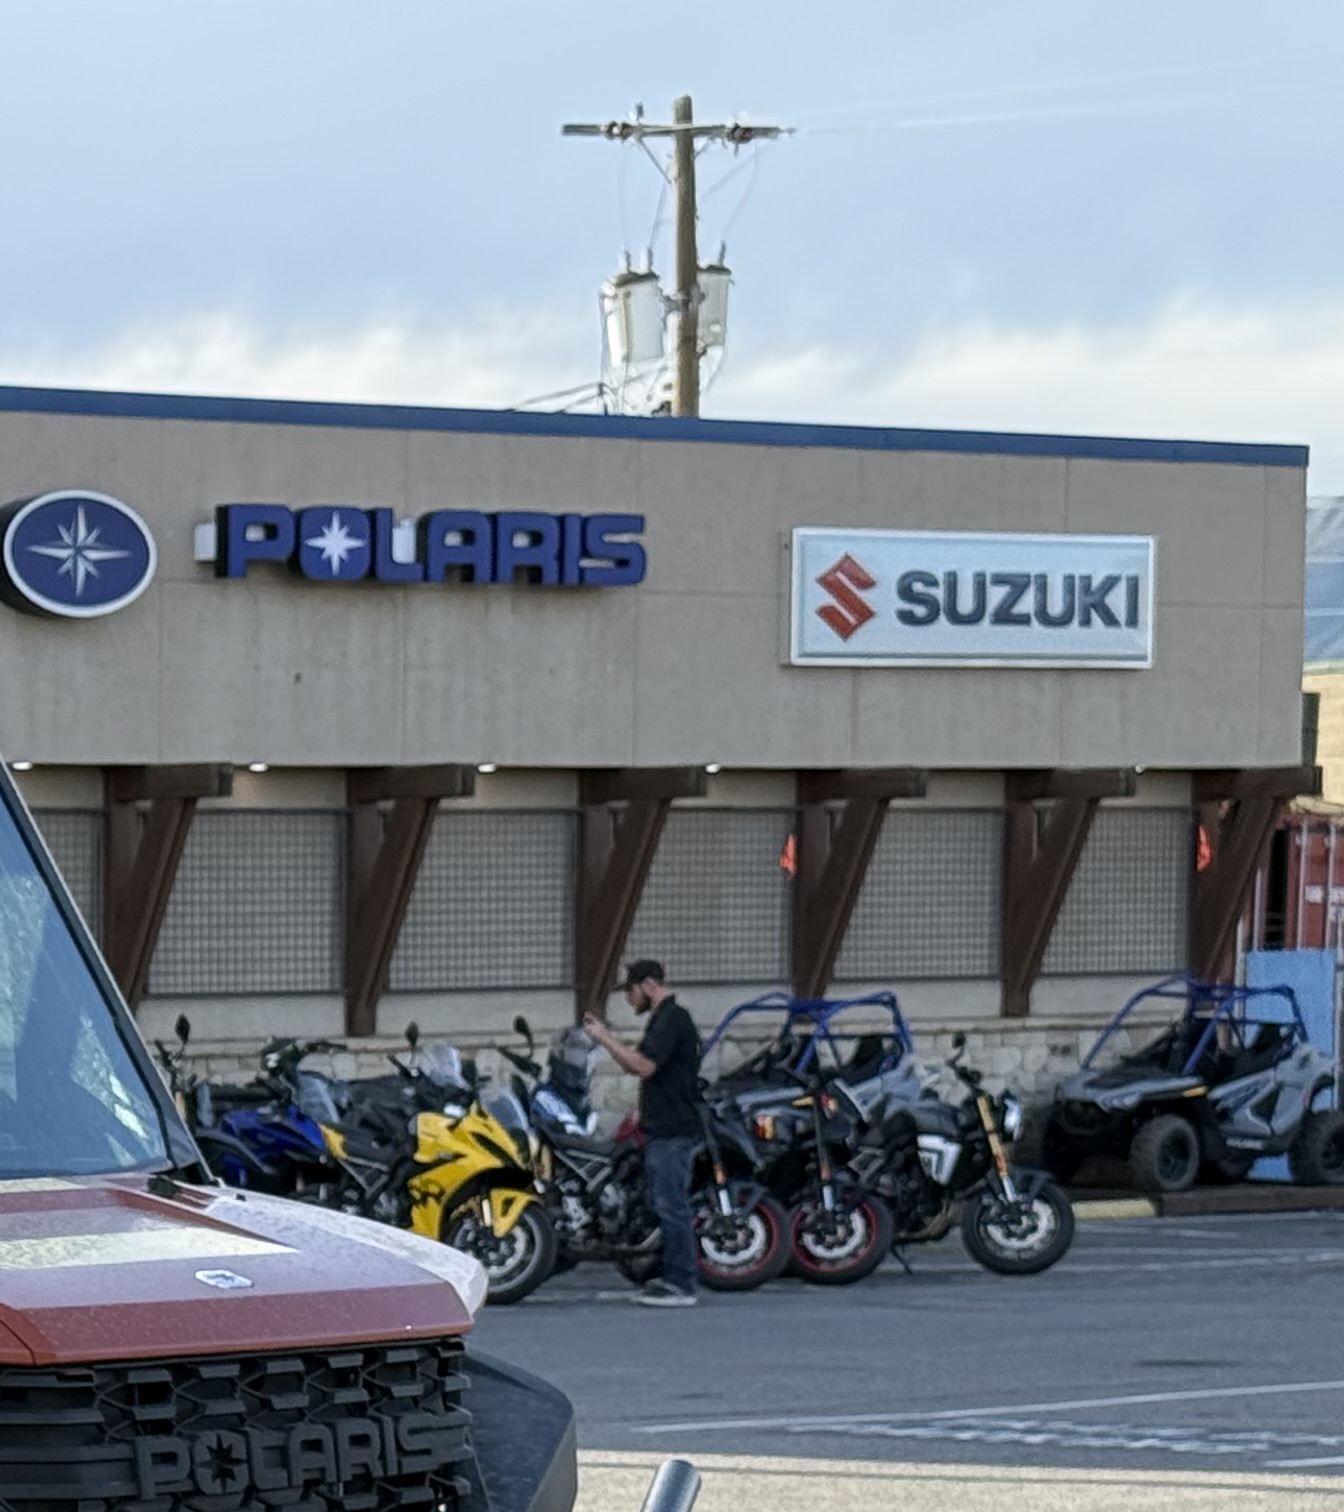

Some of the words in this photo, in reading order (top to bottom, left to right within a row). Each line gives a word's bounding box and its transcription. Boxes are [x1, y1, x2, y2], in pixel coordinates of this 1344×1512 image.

[216, 503, 647, 586] POLARIS
[894, 568, 1140, 629] SUZUKI
[133, 1410, 467, 1500] POLARIS
